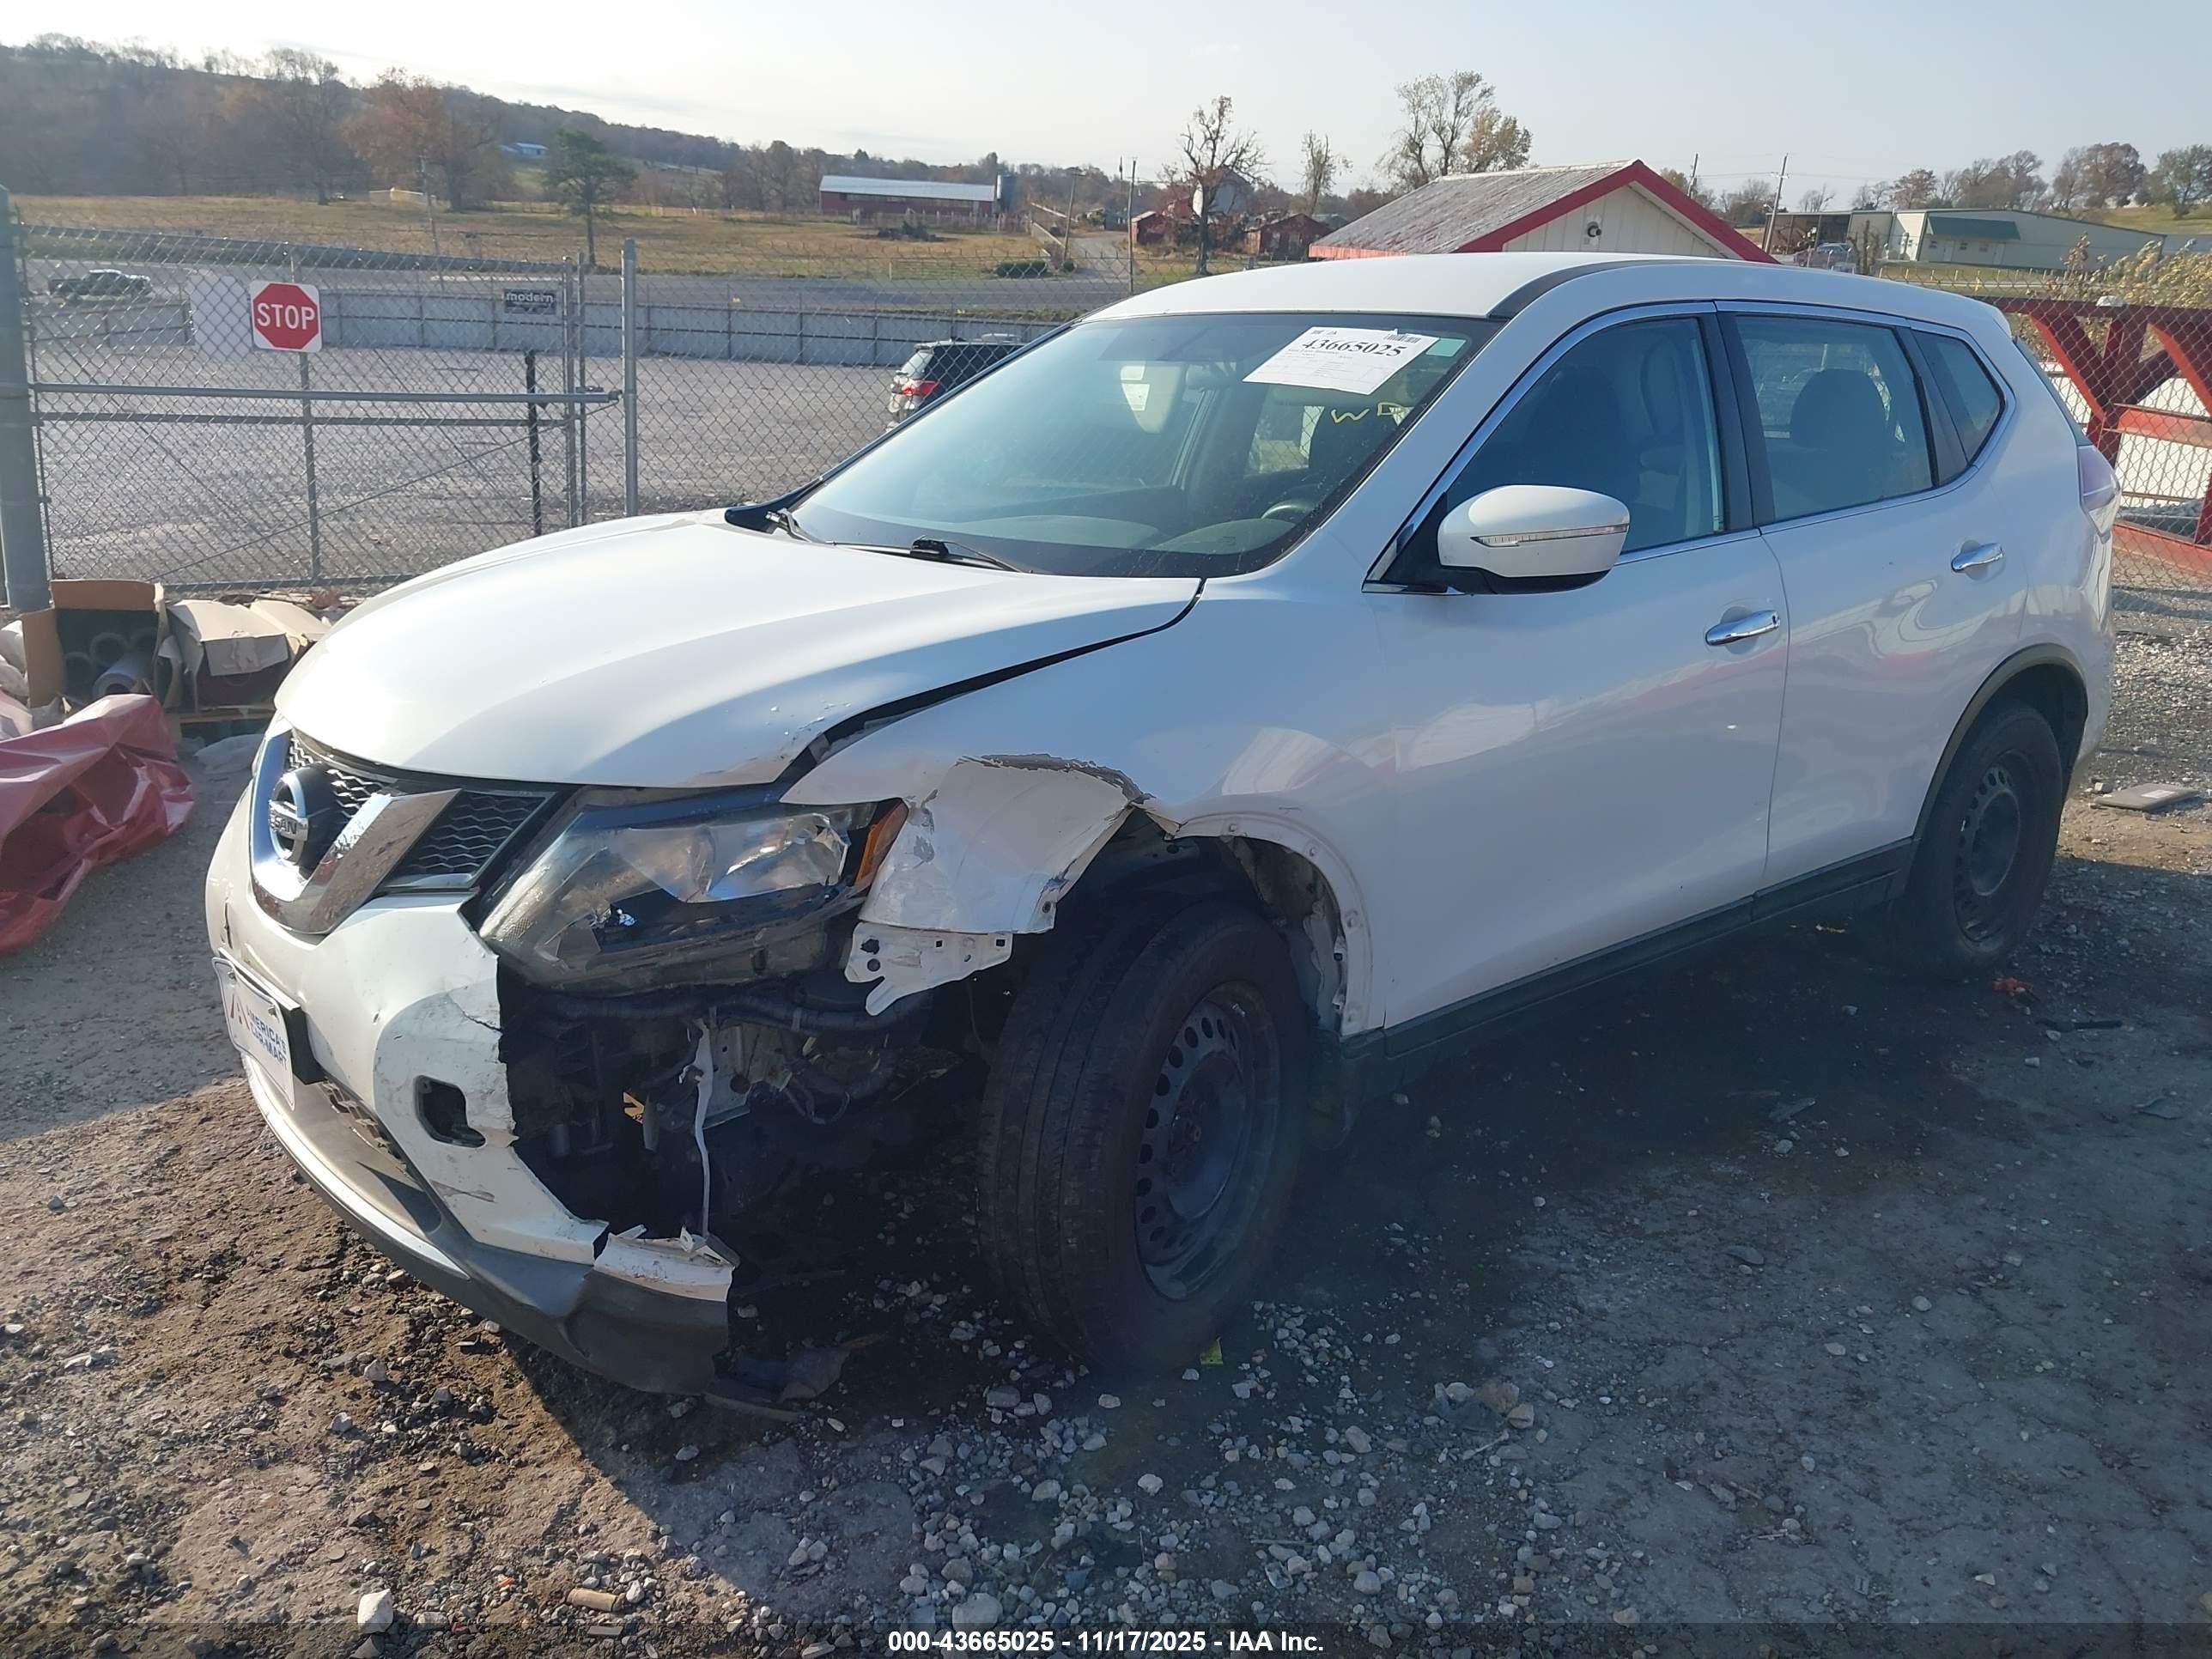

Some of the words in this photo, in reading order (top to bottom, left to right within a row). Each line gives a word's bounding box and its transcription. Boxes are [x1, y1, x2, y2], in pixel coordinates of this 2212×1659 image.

[507, 292, 554, 302] modern
[258, 302, 315, 330] STOP
[1302, 338, 1407, 356] 43665025
